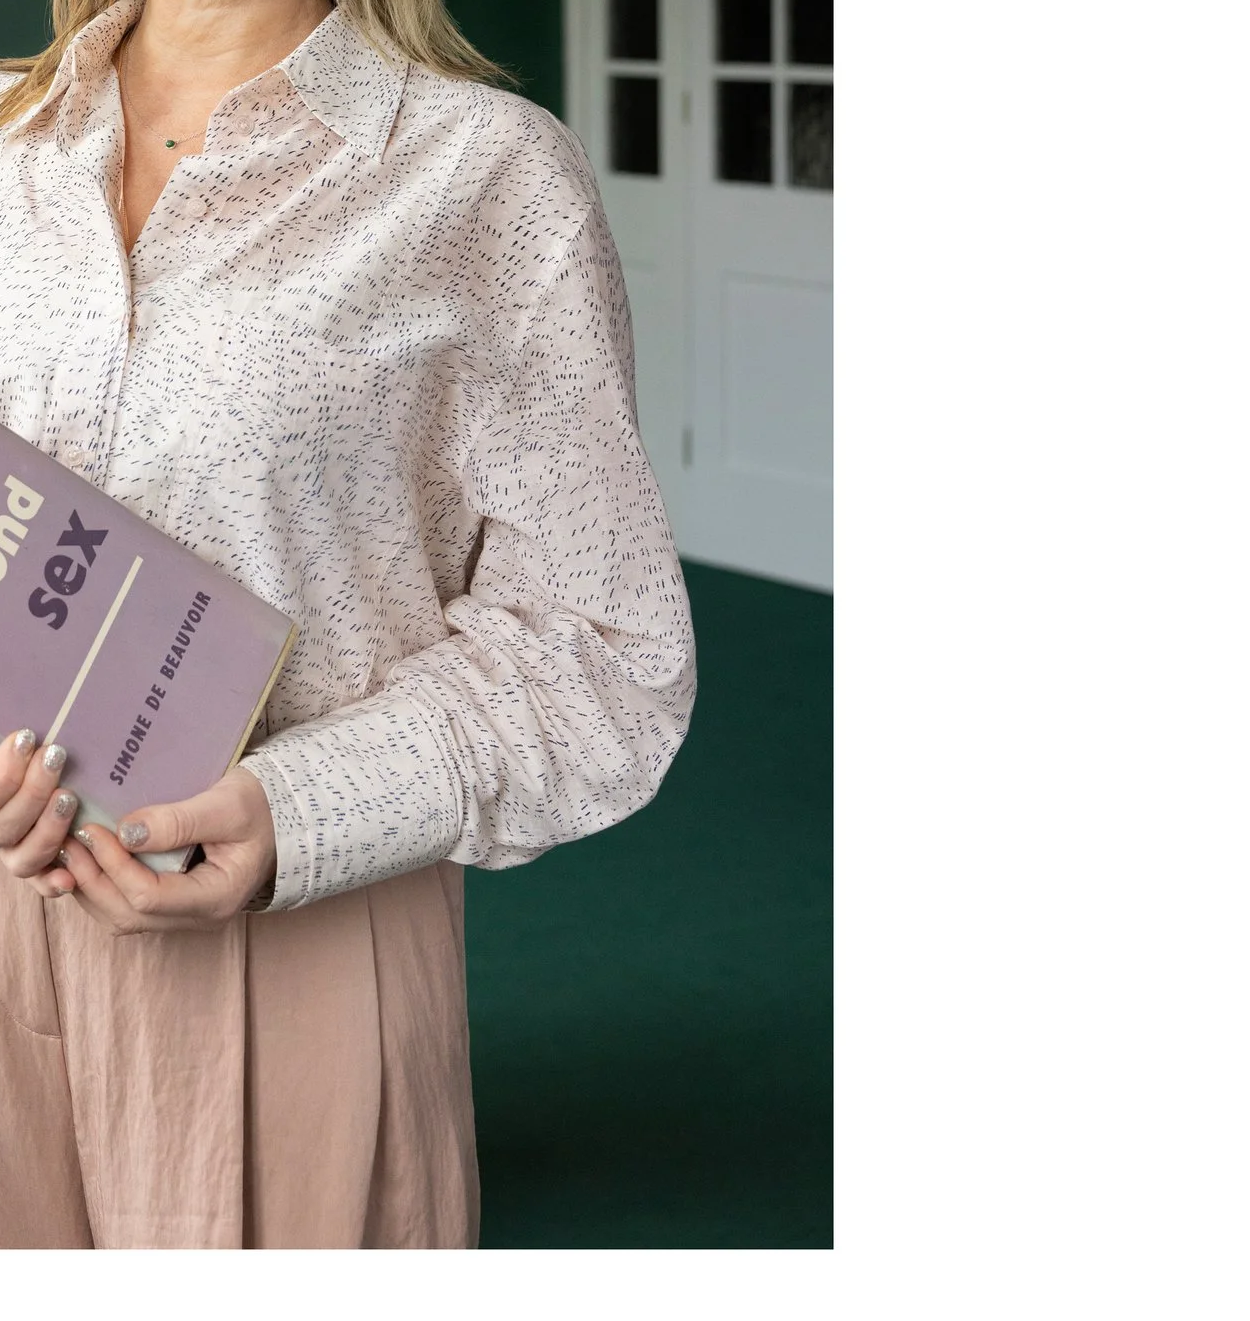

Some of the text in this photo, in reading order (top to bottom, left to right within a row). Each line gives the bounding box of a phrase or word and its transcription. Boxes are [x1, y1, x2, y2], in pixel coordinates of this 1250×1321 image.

[28, 509, 110, 631] sex
[110, 590, 212, 786] SIMONE DE BEAUVOIR
